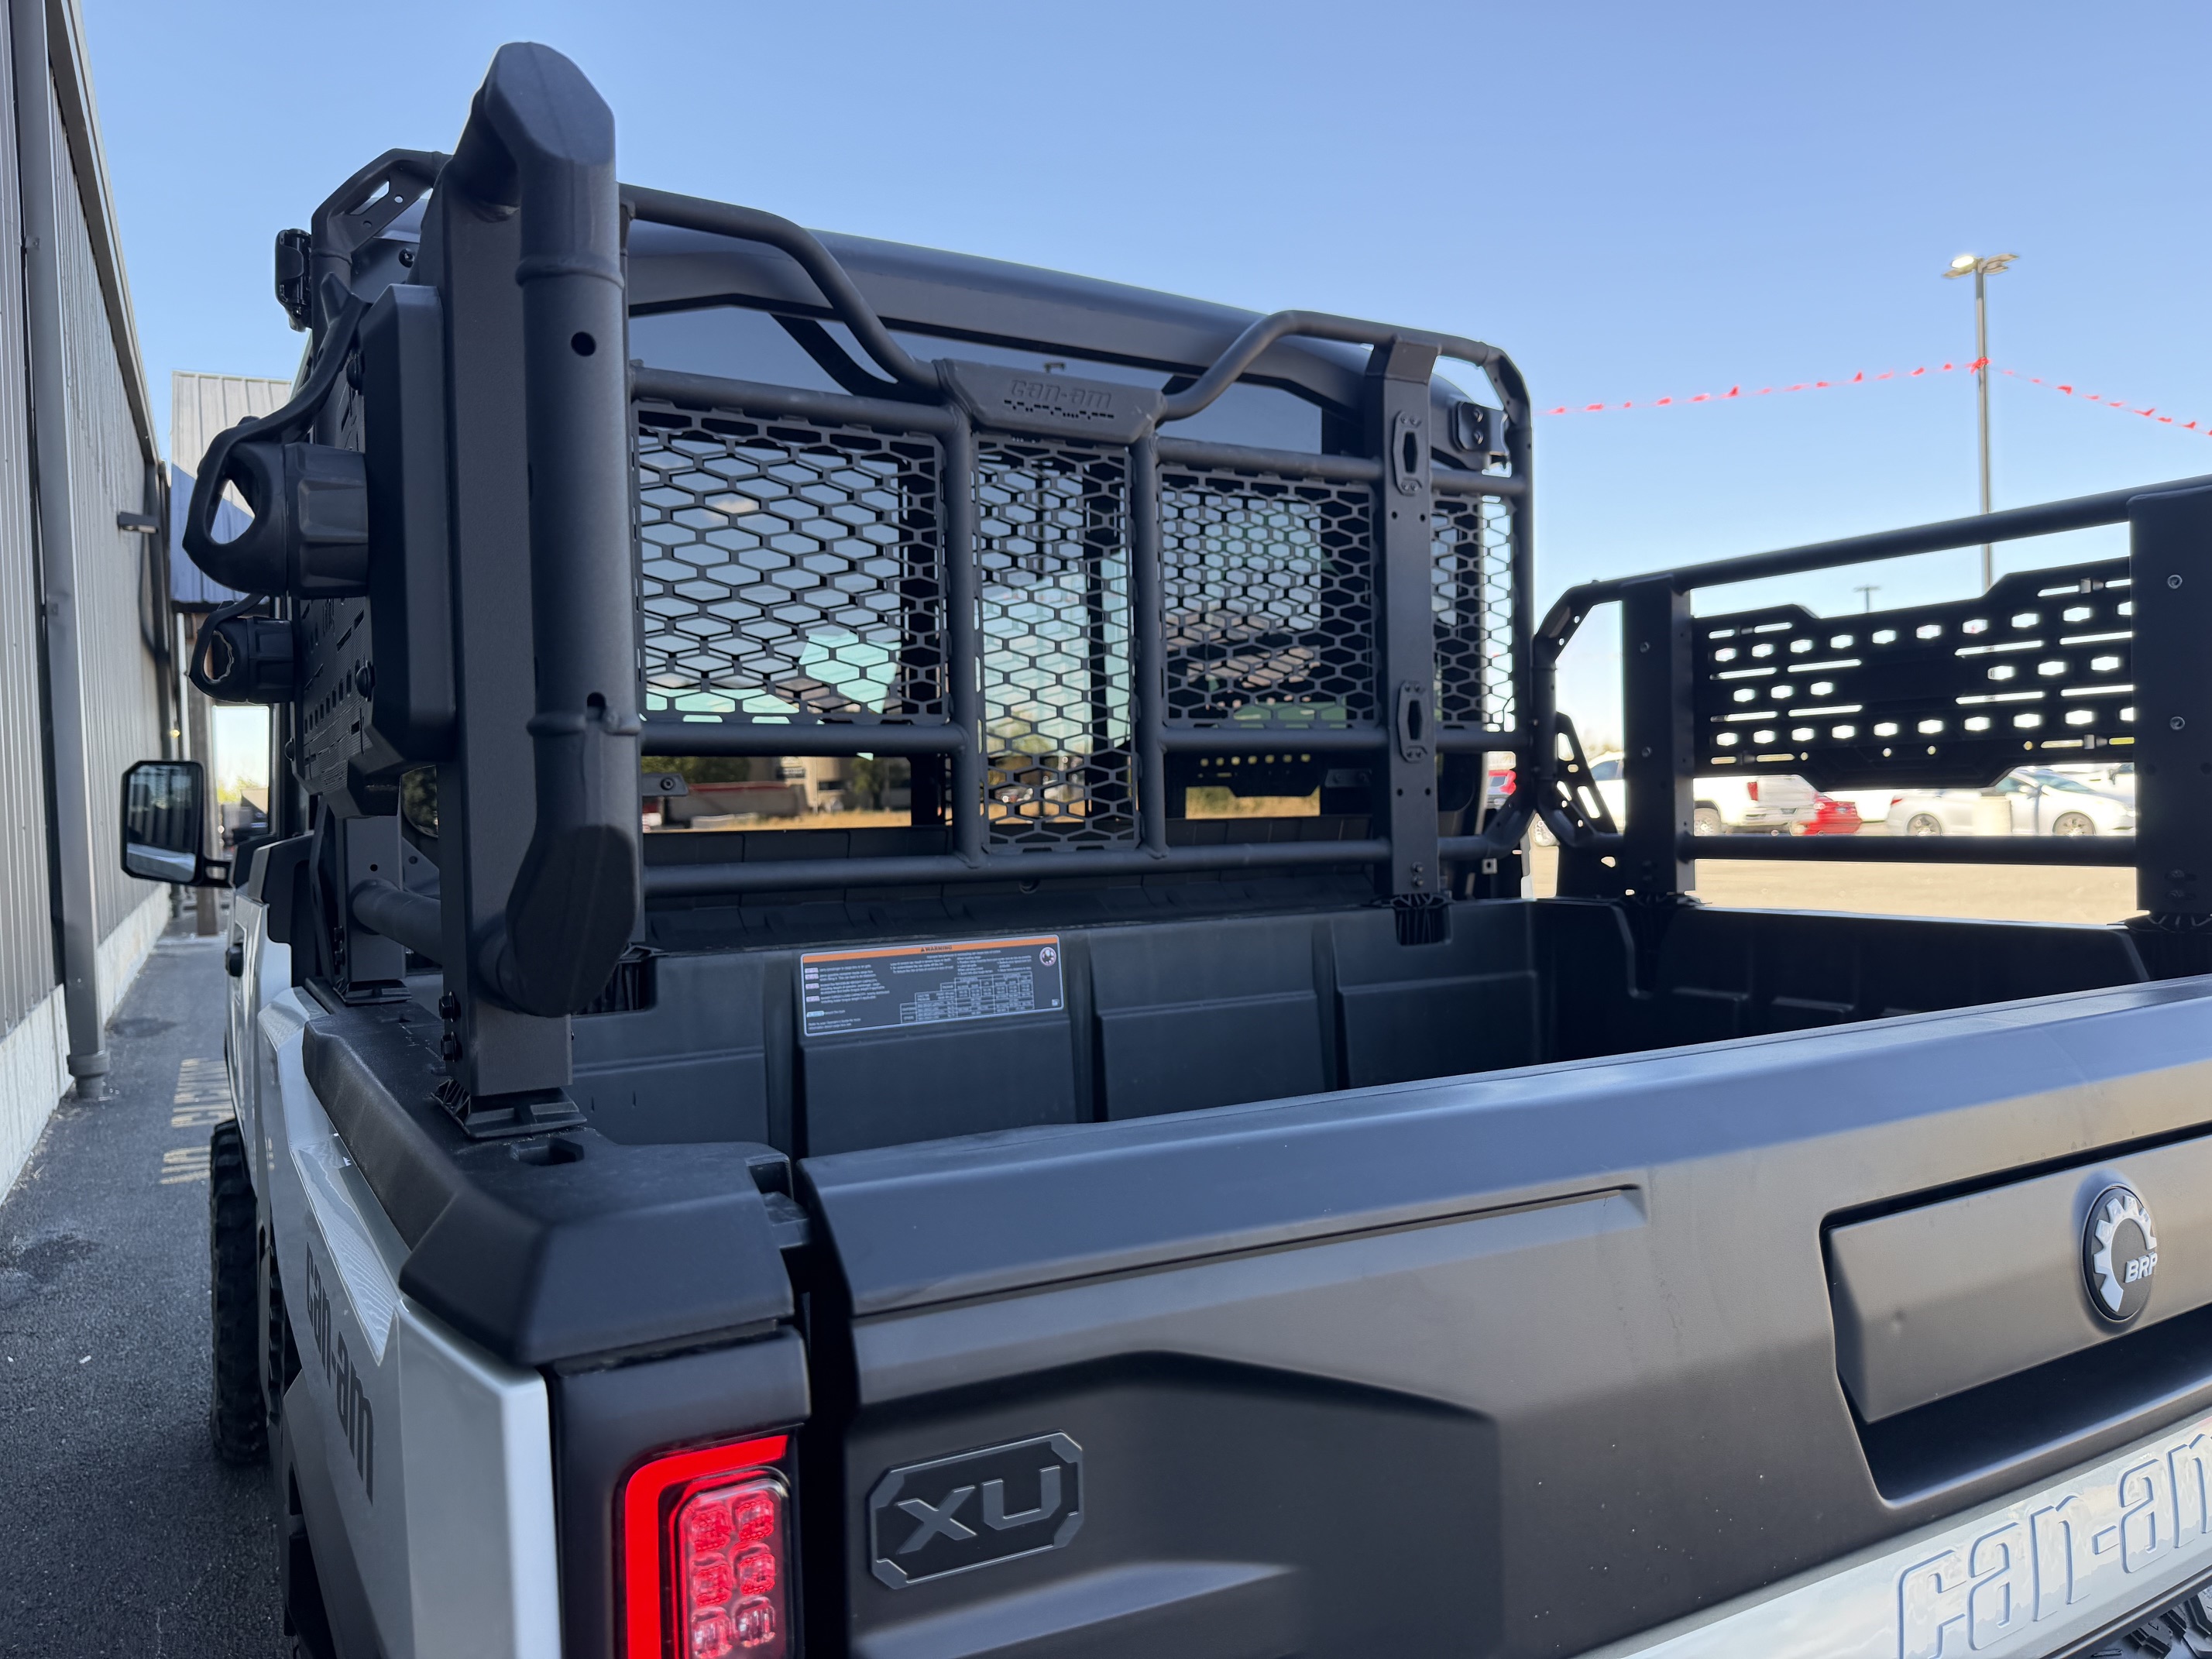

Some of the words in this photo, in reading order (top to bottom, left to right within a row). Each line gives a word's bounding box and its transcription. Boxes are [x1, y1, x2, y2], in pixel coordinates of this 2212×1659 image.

[1011, 380, 1112, 408] can-am
[2124, 1252, 2158, 1283] BRP
[307, 1241, 374, 1506] can-am
[895, 1465, 1062, 1554] XU
